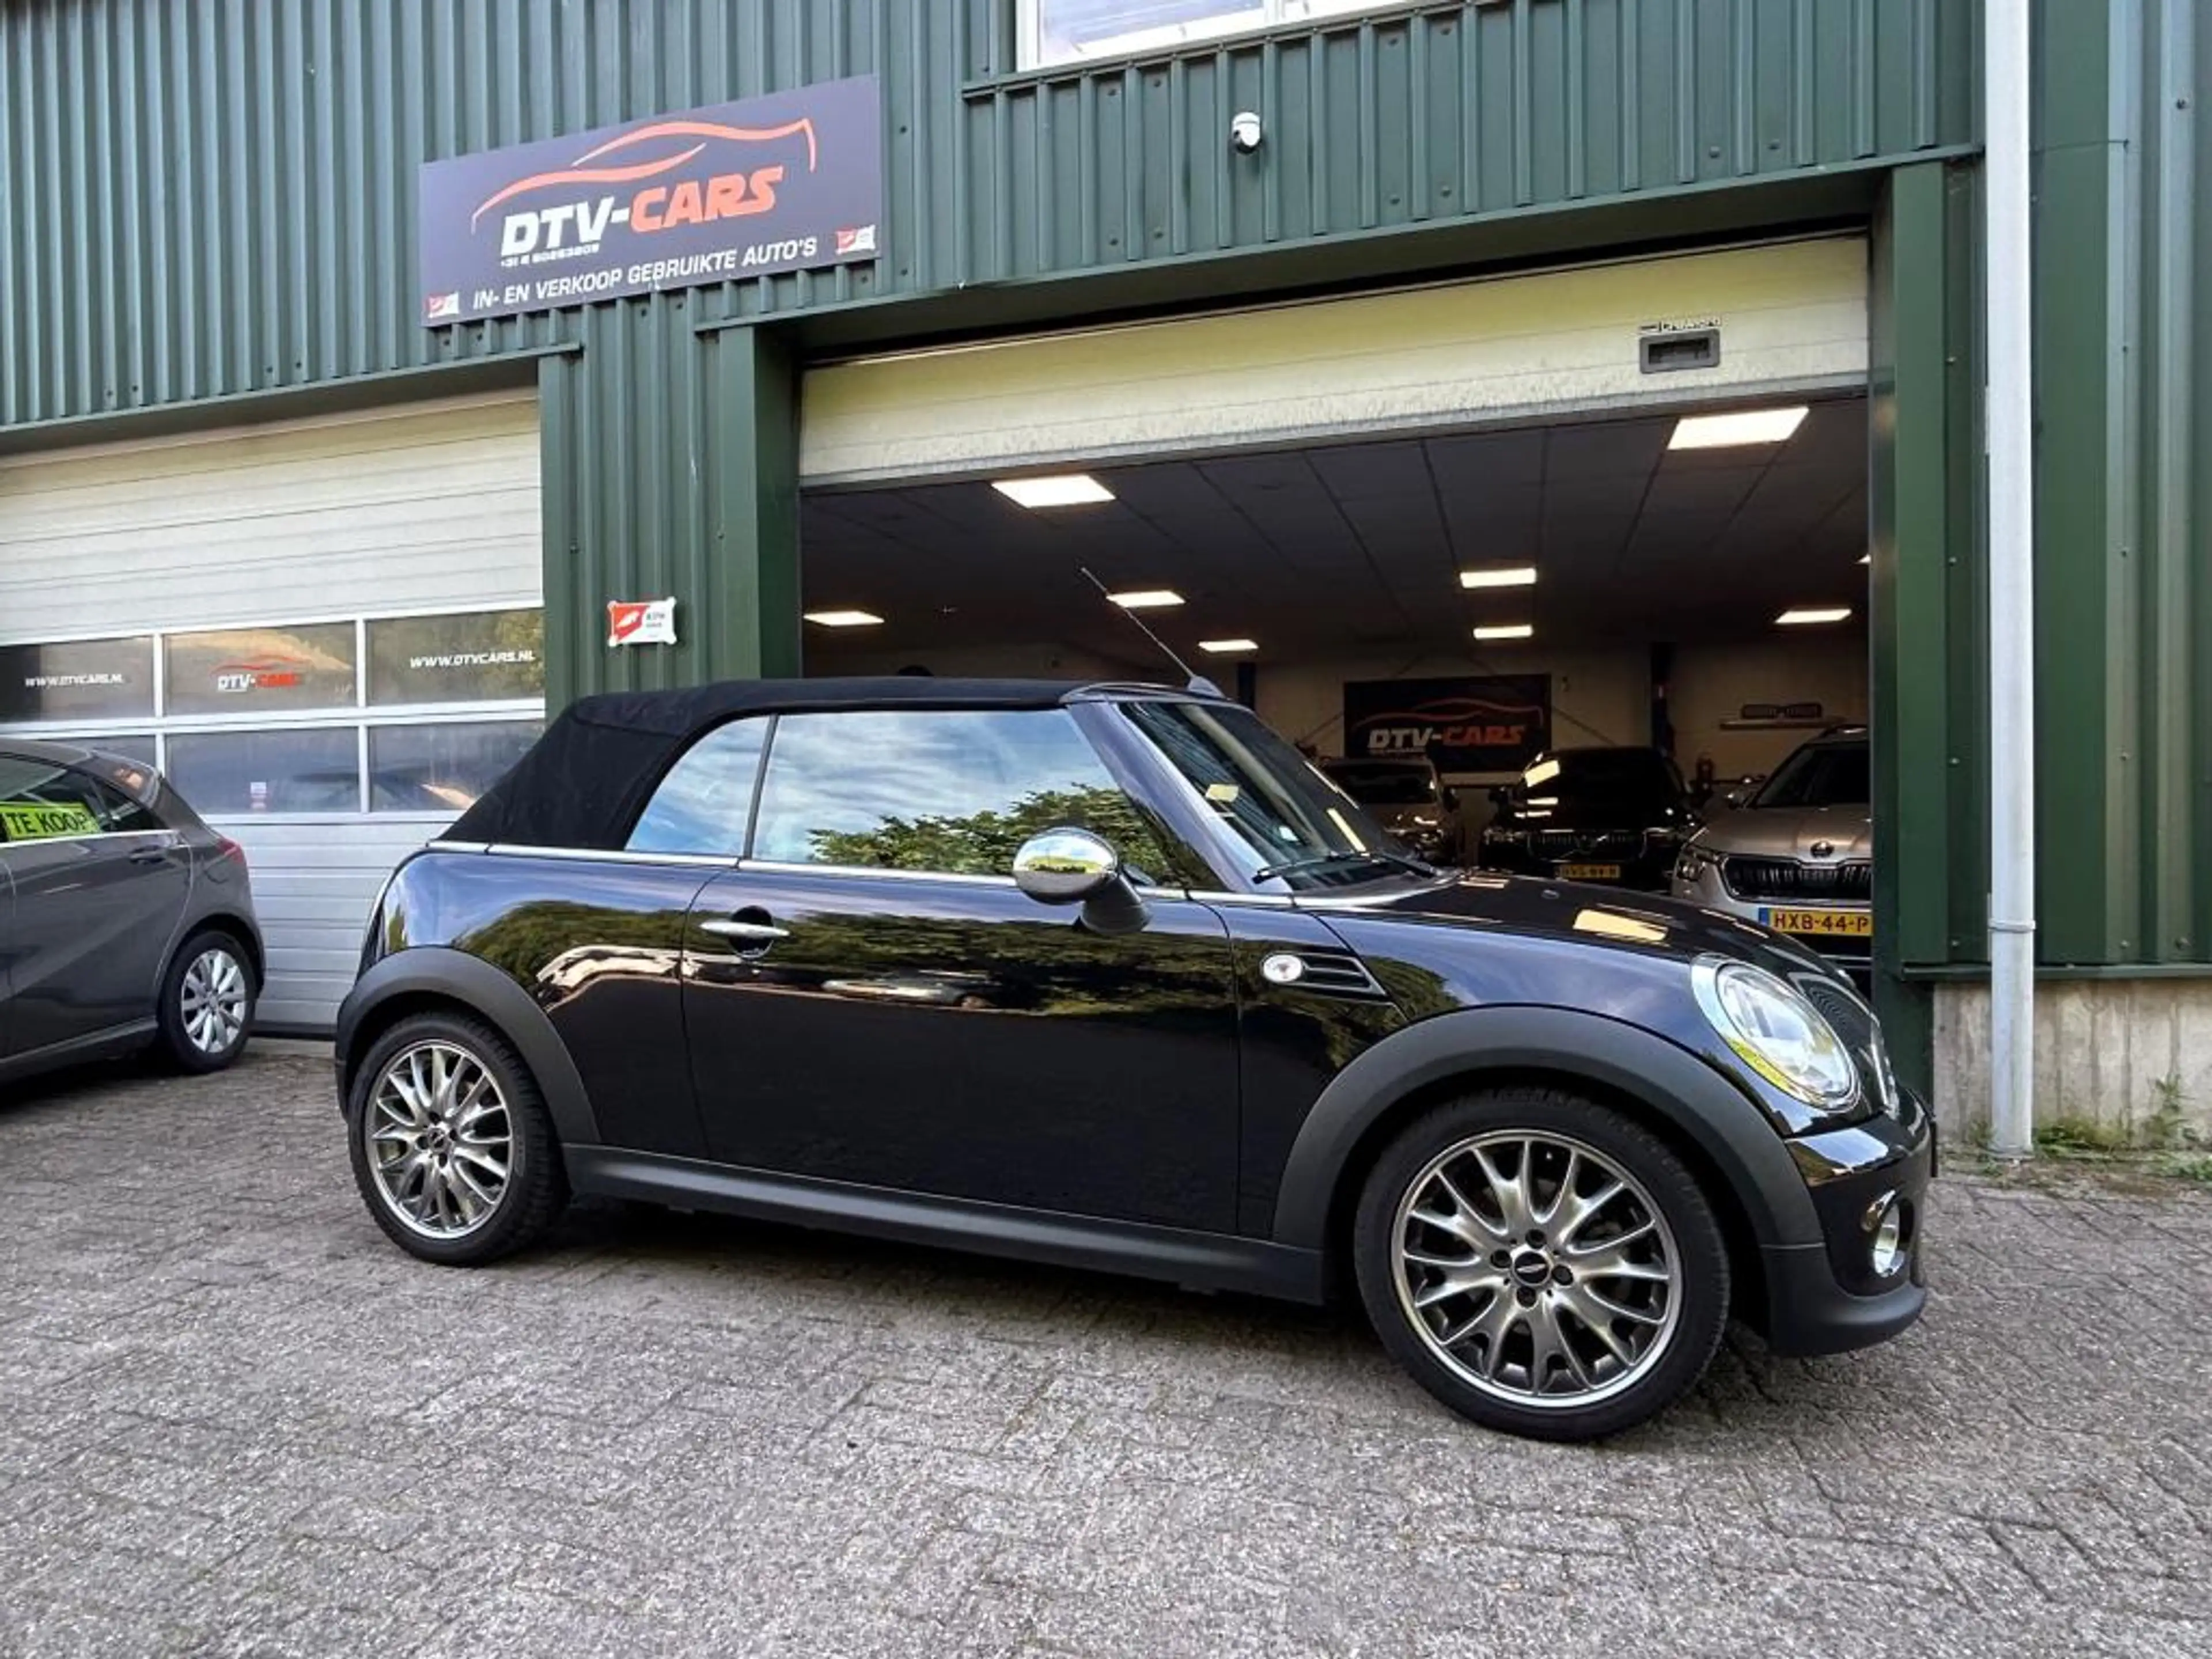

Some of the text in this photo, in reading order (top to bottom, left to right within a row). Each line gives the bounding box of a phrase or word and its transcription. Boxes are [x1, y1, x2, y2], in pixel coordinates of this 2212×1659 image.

[501, 165, 784, 256] DTV-CARS
[473, 288, 499, 310] IN-
[503, 283, 529, 305] EN
[535, 267, 623, 300] VERKOOP
[628, 248, 737, 284] GEBRUIKTE
[742, 236, 817, 267] AUTO'S
[1368, 726, 1525, 748] DTV-CARS
[5, 810, 86, 834] TE KOOP
[1774, 912, 1869, 932] HXB-44-P
